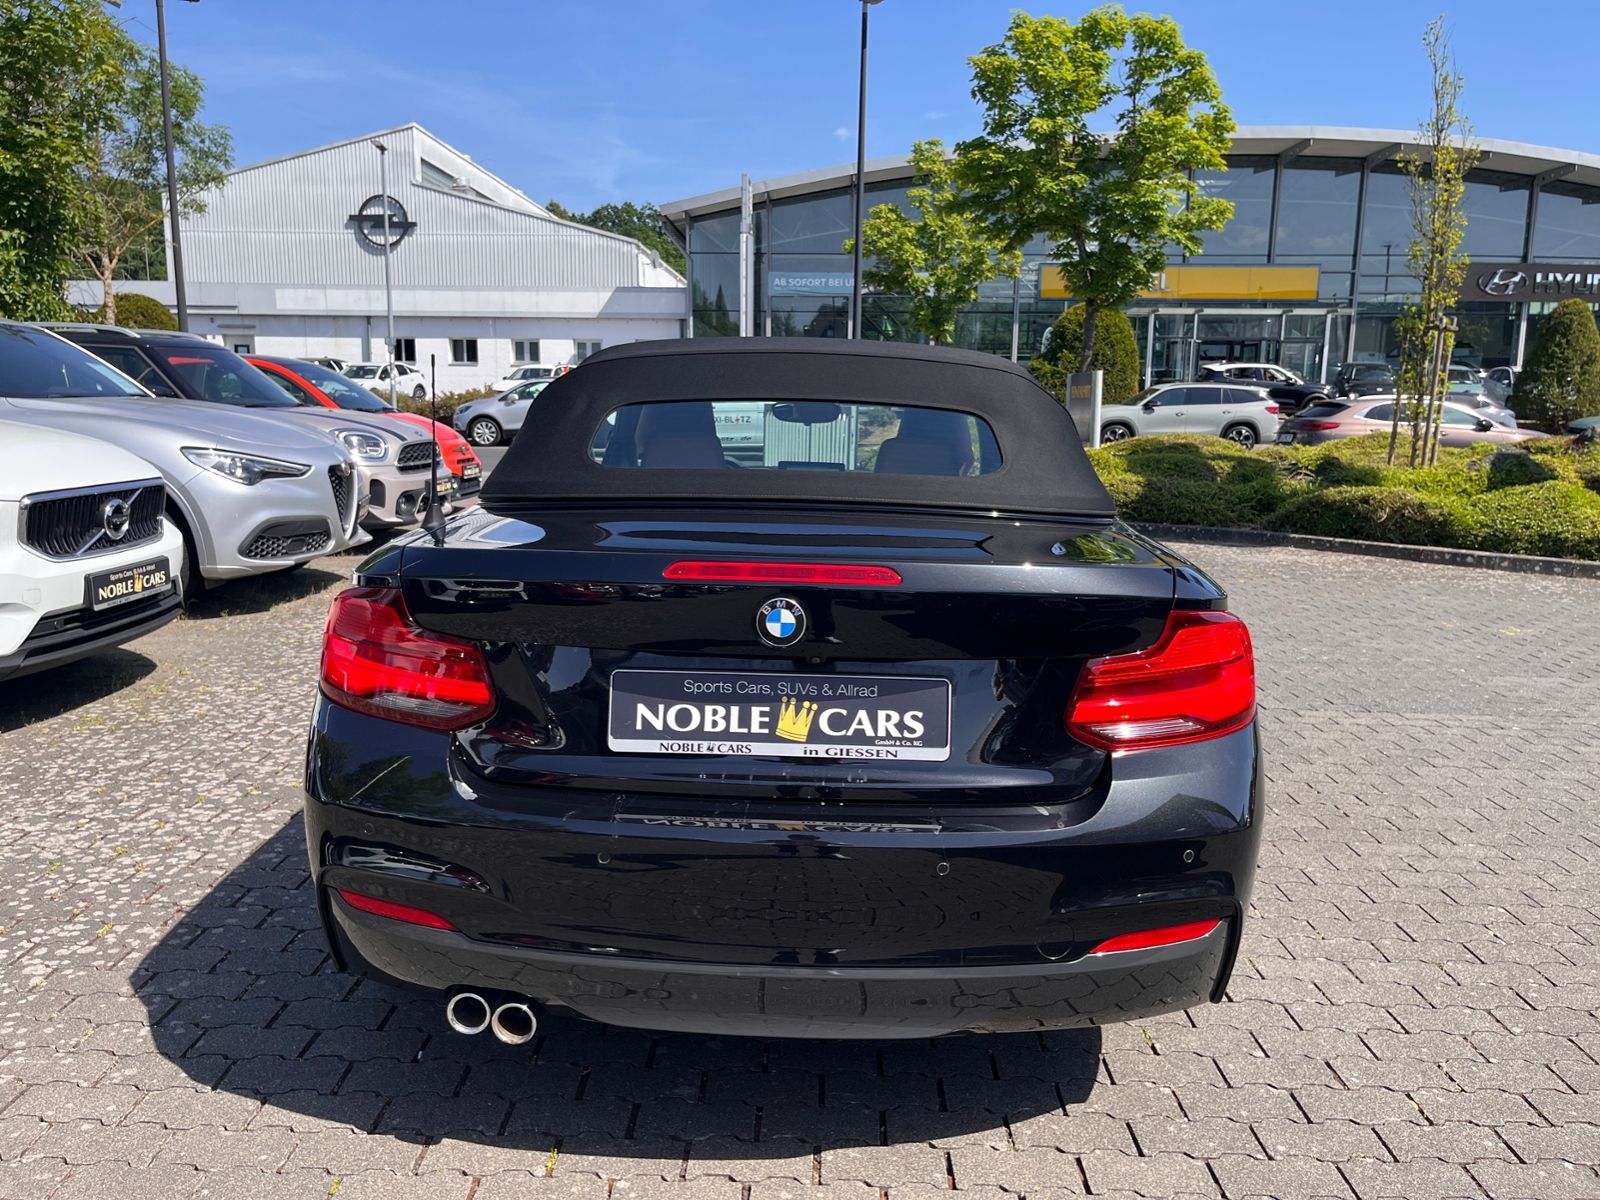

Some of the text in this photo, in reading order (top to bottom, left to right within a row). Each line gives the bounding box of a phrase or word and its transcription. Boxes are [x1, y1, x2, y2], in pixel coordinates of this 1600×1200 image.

[774, 278, 786, 287] AB
[787, 278, 826, 287] SOFORT
[829, 278, 843, 287] BEI
[98, 579, 134, 600] NOBLE
[143, 570, 166, 587] CARS
[683, 679, 878, 697] Sports Cars, SUVs & Allrad
[635, 703, 925, 739] NOBLE CARS
[659, 742, 752, 754] NOBLE CARS
[803, 746, 898, 758] in GIESSEN
